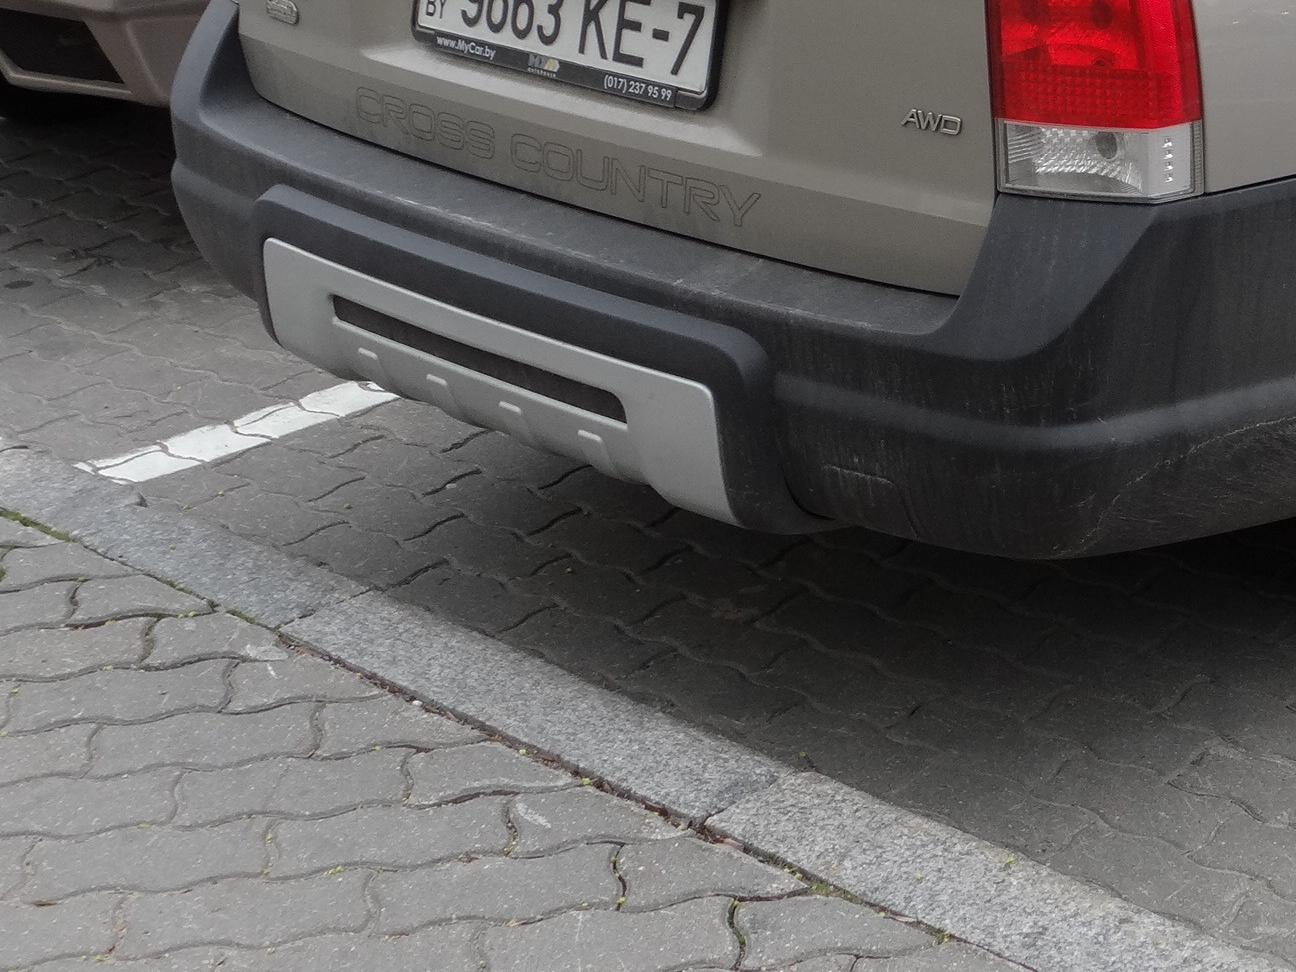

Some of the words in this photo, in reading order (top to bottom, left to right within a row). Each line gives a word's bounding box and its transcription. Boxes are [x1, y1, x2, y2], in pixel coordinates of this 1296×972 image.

[436, 36, 496, 60] www.MyCar.by
[603, 74, 627, 94] (017)
[628, 80, 646, 95] 237
[647, 85, 659, 98] 95
[660, 88, 673, 101] 99
[900, 107, 963, 135] AWD
[355, 86, 496, 160] CROSS
[510, 132, 761, 228] COUNTRY
